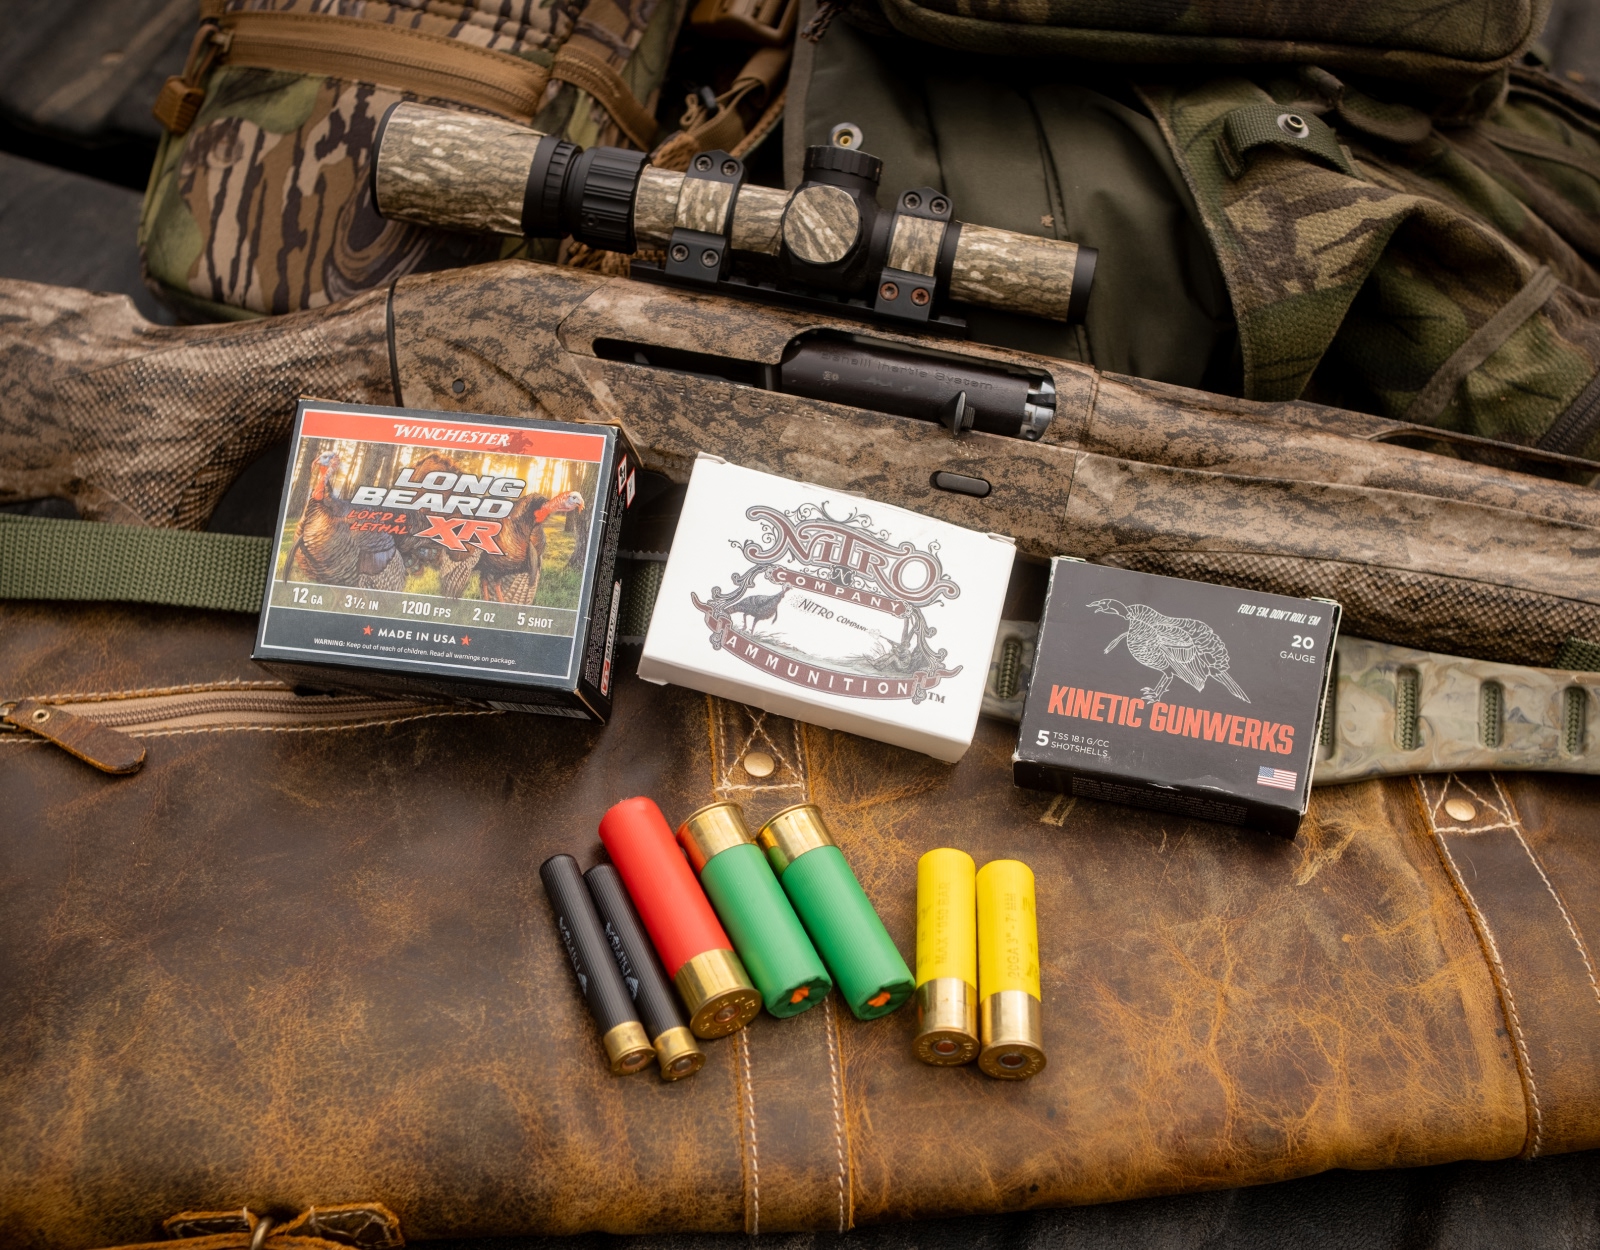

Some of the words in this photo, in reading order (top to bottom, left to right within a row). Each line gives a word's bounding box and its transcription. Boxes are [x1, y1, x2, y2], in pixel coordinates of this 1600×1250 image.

[393, 424, 510, 447] WINCHESTER
[394, 467, 527, 498] LONG
[350, 486, 514, 518] BEARD
[347, 510, 394, 521] LOK'D
[394, 514, 408, 524] &
[350, 521, 410, 535] LETHAL
[413, 515, 506, 556] XR
[745, 506, 960, 606] NITRO
[776, 571, 902, 612] COMPANY
[293, 587, 309, 604] 12
[310, 594, 323, 606] GA
[368, 600, 379, 611] IN
[401, 600, 431, 616] 1200
[433, 607, 452, 618] FPS
[472, 607, 482, 622] 2
[483, 612, 496, 623] OZ
[517, 612, 526, 626] 5
[527, 617, 554, 629] SHOT
[798, 598, 834, 620] NITRO
[836, 615, 869, 632] COMPANY
[1237, 603, 1256, 615] FOLD
[1269, 608, 1292, 621] DON'T
[1289, 612, 1307, 624] ROLL
[377, 628, 413, 640] MADE
[416, 631, 429, 642] IN
[433, 633, 457, 645] USA
[1291, 634, 1315, 650] 20
[313, 637, 346, 648] WARNING:
[346, 641, 362, 650] Keep
[372, 643, 380, 651] of
[380, 645, 396, 653] reach
[403, 647, 429, 656] children.
[429, 649, 445, 658] Read
[453, 653, 481, 662] warnings
[490, 657, 517, 666] package.
[1279, 650, 1316, 664] GAUGE
[726, 635, 909, 696] AMMUNITION
[928, 691, 946, 704] TM
[1047, 684, 1146, 728] KINETIC
[1149, 702, 1295, 755] GUNWERKS
[1035, 729, 1050, 747] 5
[1053, 731, 1069, 741] TSS
[1071, 734, 1085, 744] 18.1
[1086, 737, 1110, 748] G/CC
[1050, 741, 1109, 757] SHOTSHELLS
